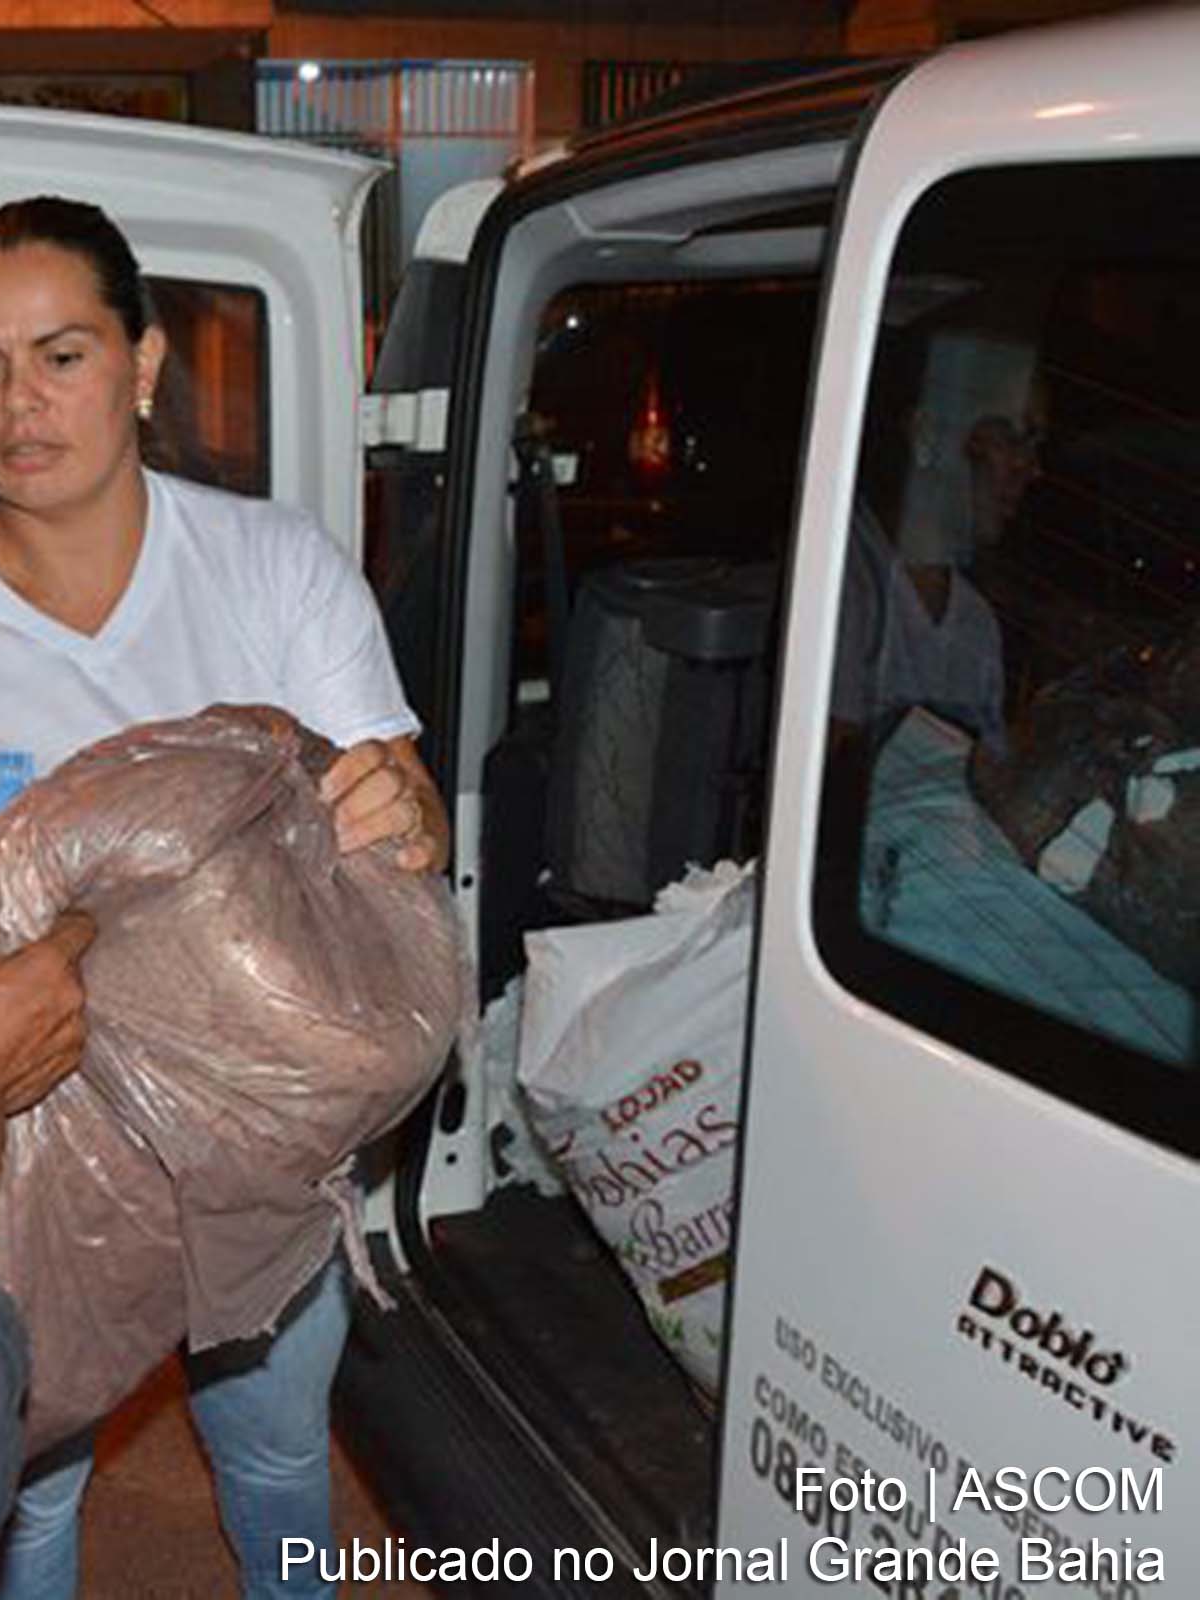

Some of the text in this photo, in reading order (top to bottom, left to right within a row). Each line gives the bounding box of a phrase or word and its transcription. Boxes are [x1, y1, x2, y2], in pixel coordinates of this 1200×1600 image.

[753, 1374, 828, 1459] COMO
[774, 1316, 817, 1372] USO
[820, 1353, 948, 1474] EXCLUSIVO
[957, 1314, 1176, 1463] ATTRACTIVE
